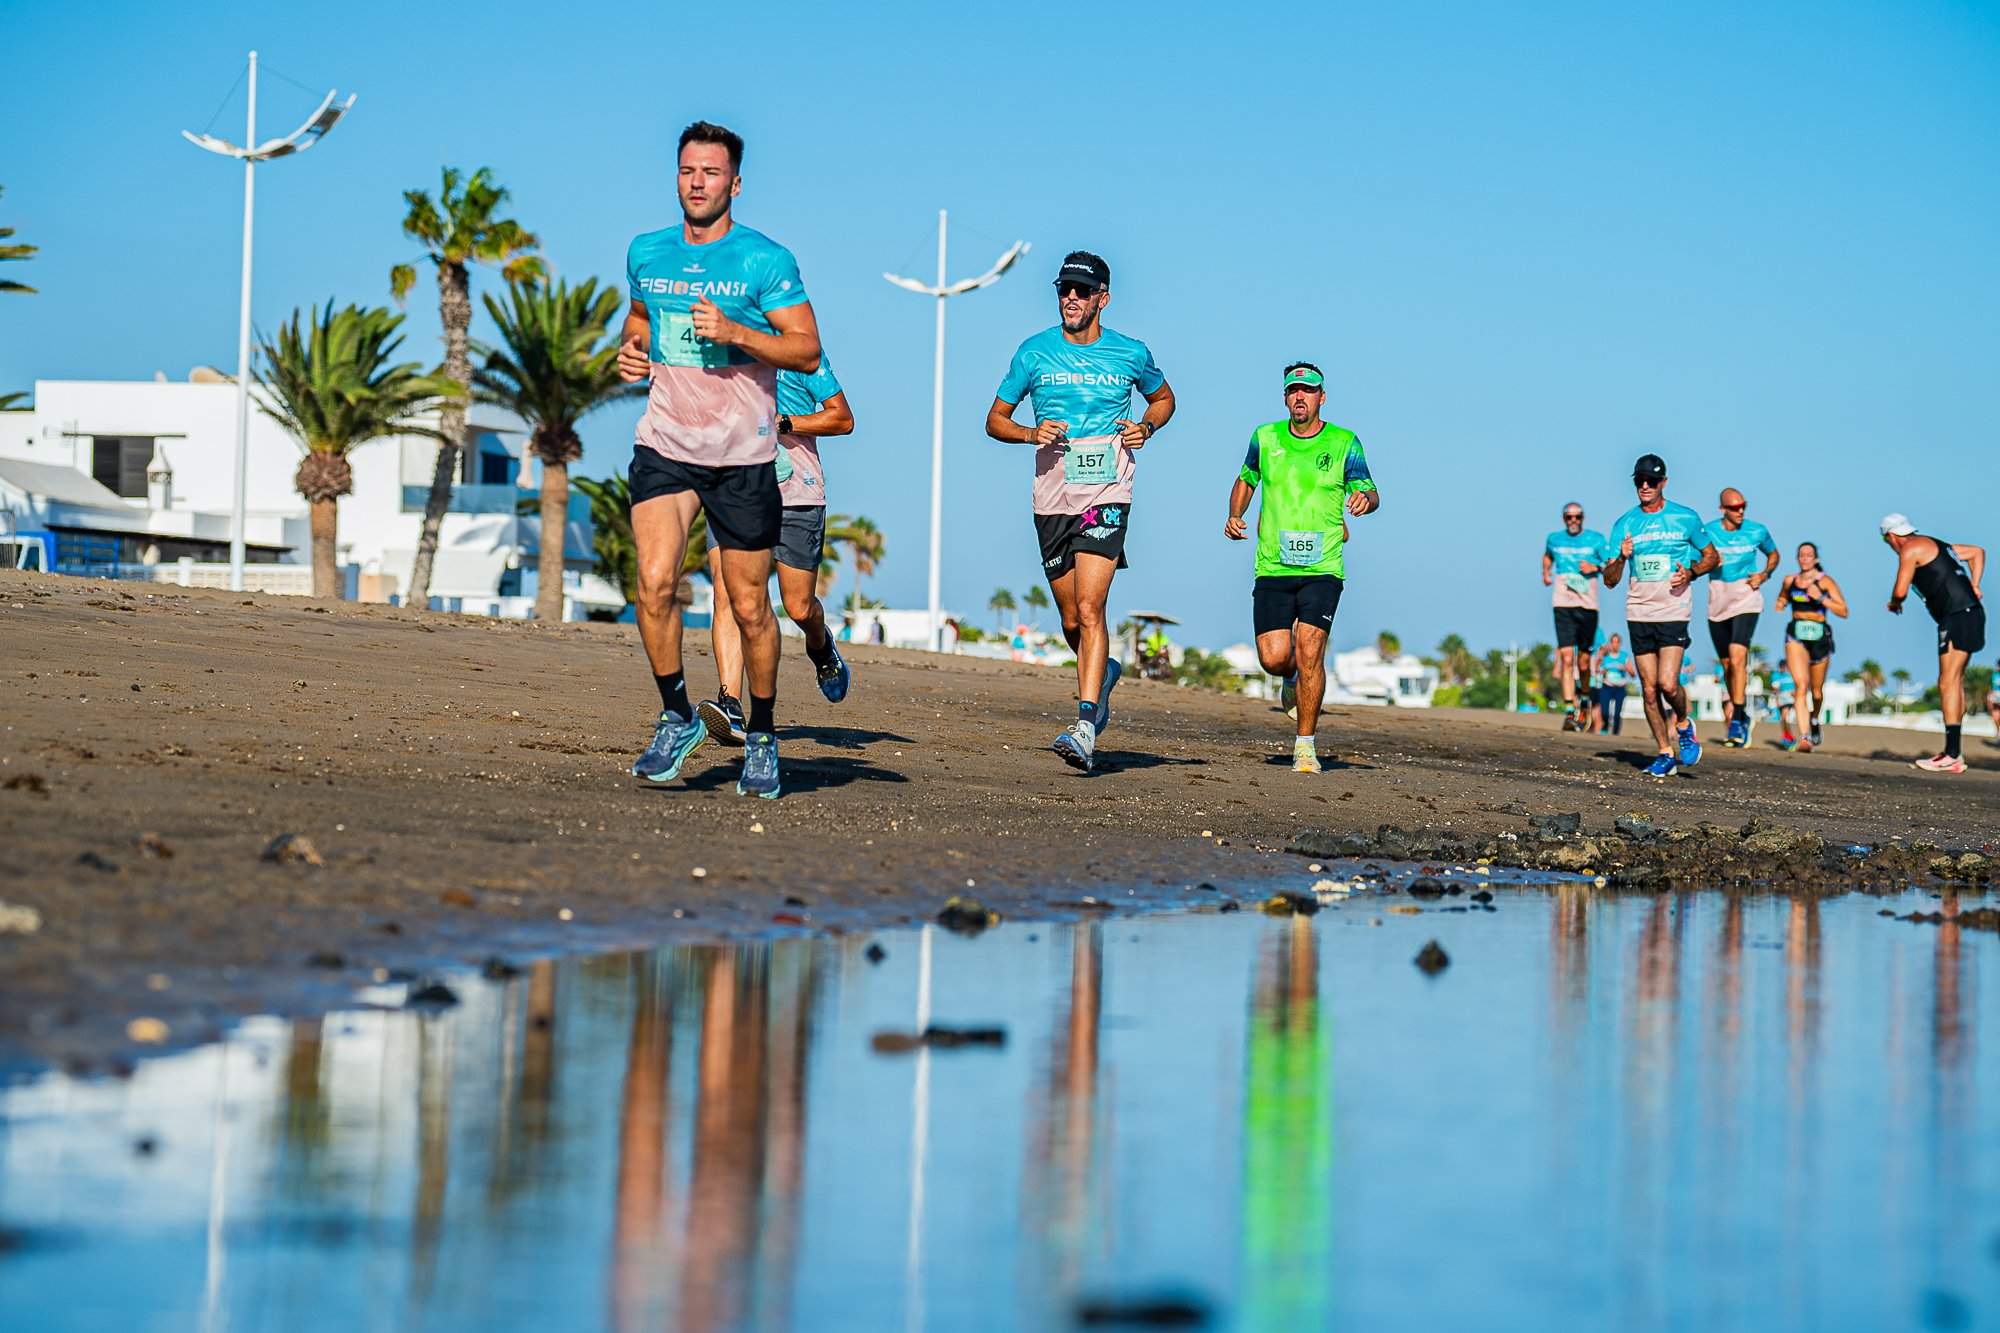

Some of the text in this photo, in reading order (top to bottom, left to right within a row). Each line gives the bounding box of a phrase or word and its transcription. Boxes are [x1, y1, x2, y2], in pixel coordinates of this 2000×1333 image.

[1077, 453, 1105, 467] 157
[1288, 540, 1314, 551] 165
[1641, 560, 1661, 571] 172
